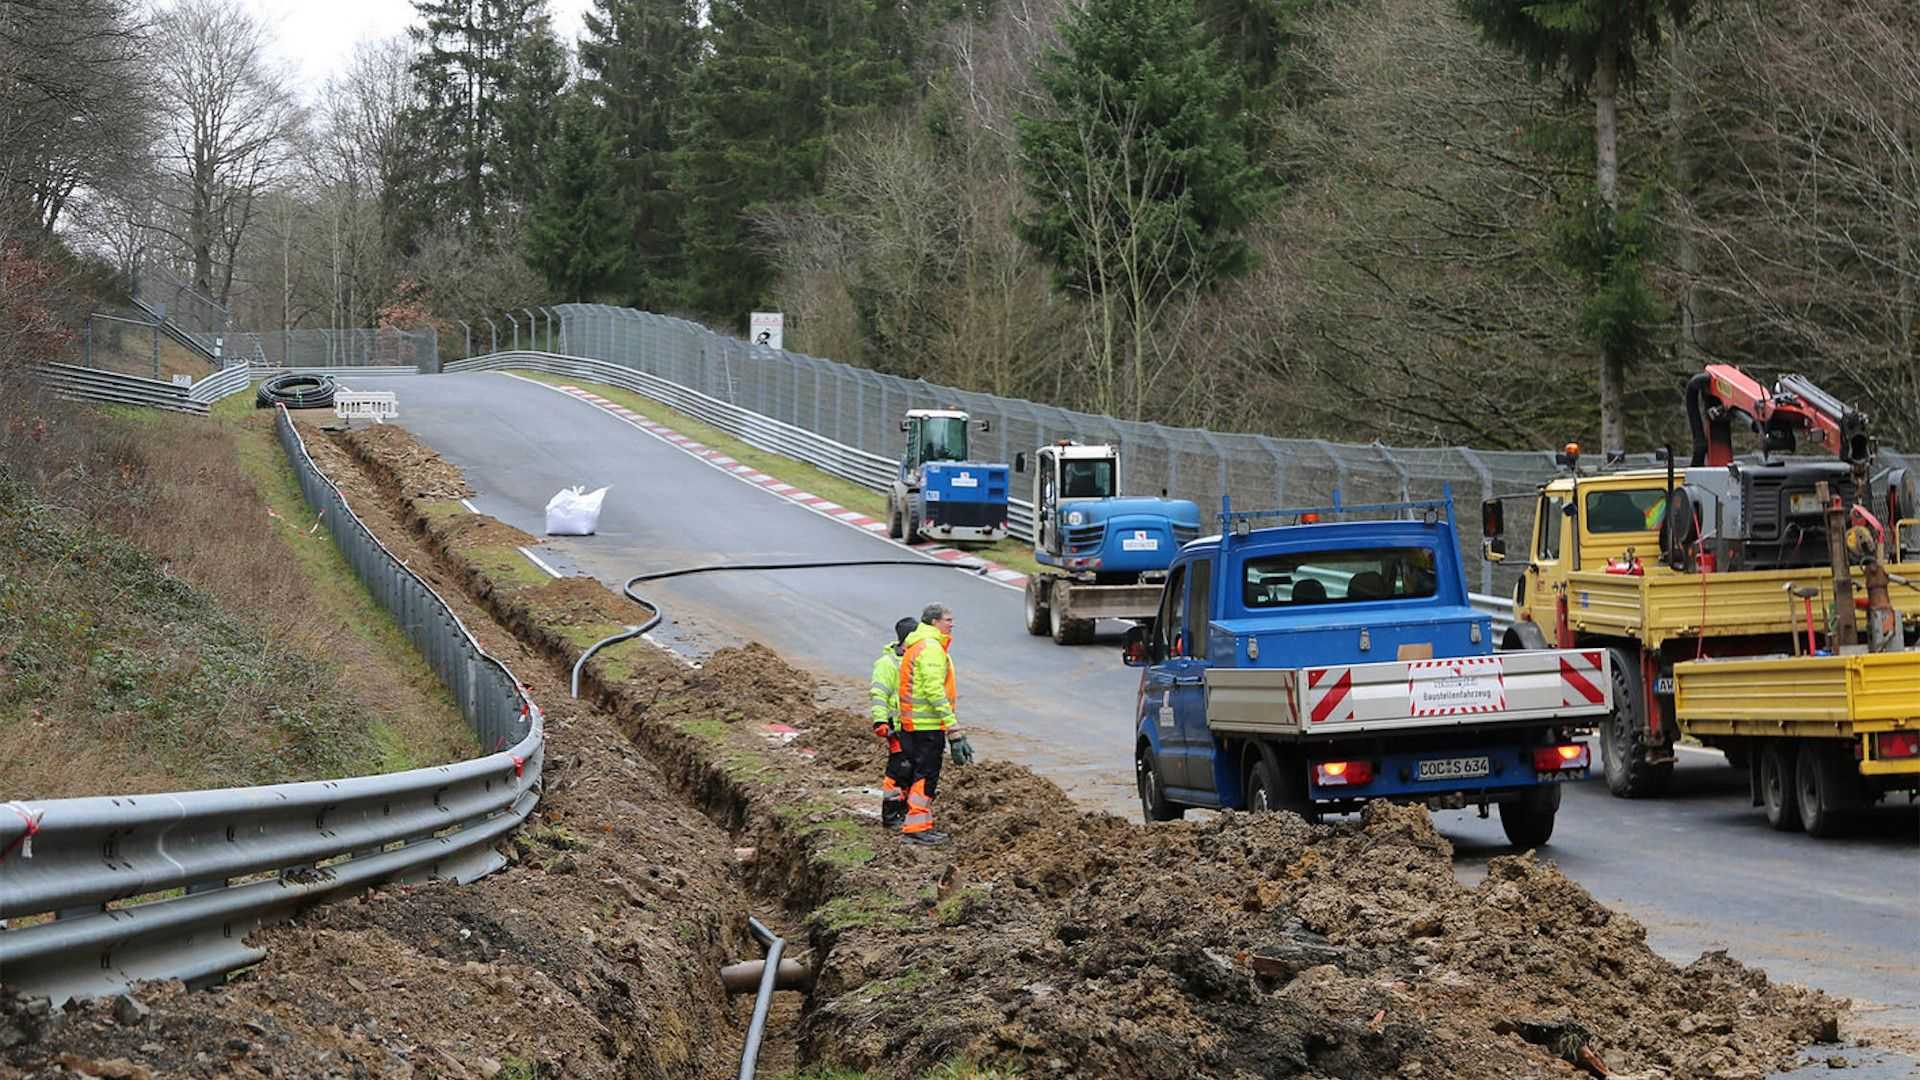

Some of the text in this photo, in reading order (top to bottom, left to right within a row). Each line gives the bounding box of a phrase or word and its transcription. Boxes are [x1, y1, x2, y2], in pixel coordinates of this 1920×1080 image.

[1423, 689, 1492, 702] Baustellenfahrzeug
[1420, 760, 1488, 776] COC S 634
[1537, 769, 1585, 783] MAN
